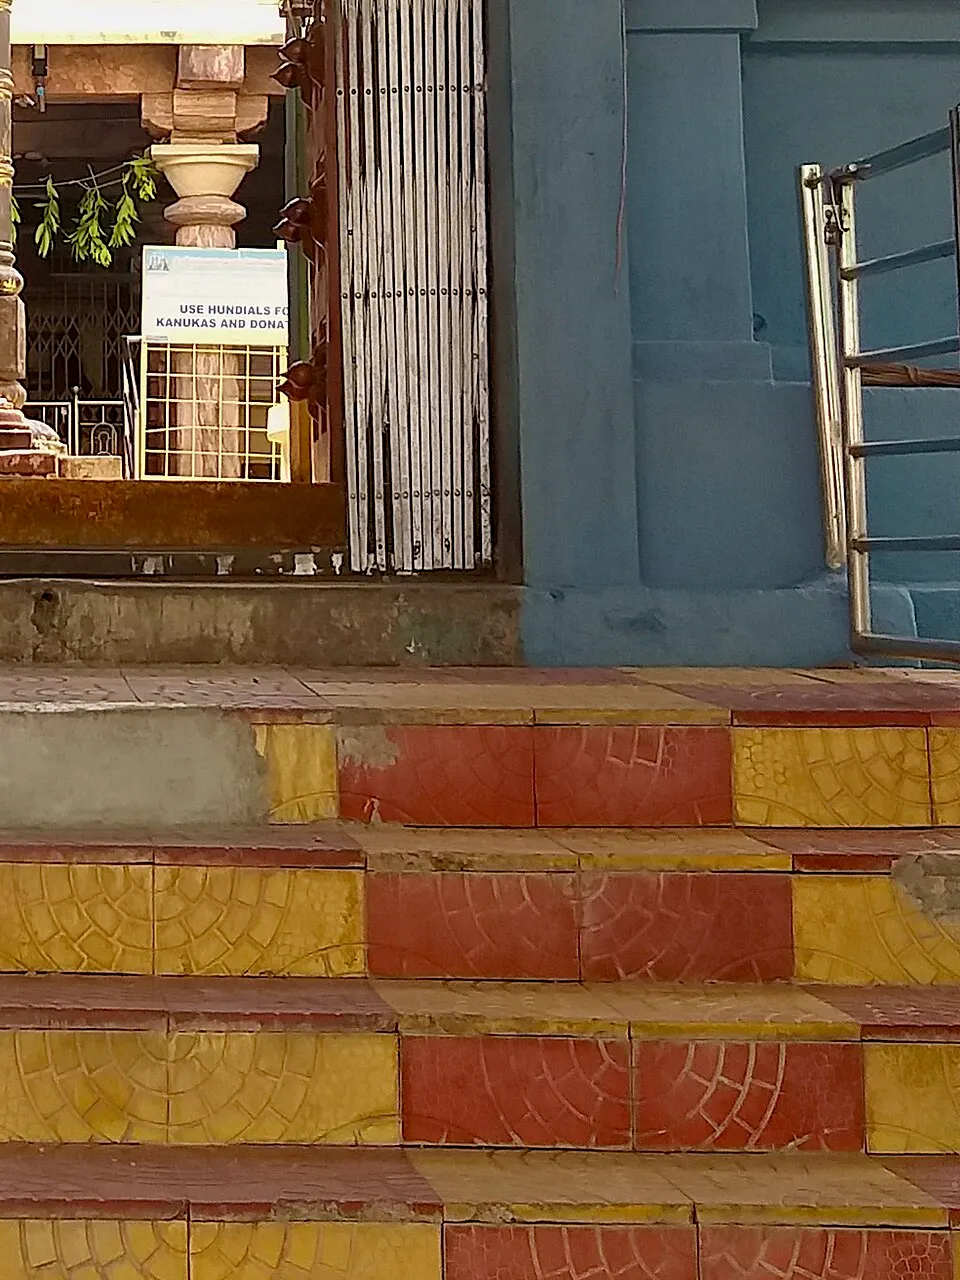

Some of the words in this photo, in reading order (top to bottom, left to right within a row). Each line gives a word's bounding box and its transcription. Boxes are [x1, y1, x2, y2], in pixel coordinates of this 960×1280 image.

[179, 305, 204, 314] USE
[208, 305, 271, 316] HUNDIALS
[156, 318, 216, 328] KANUKAS
[220, 319, 246, 329] AND
